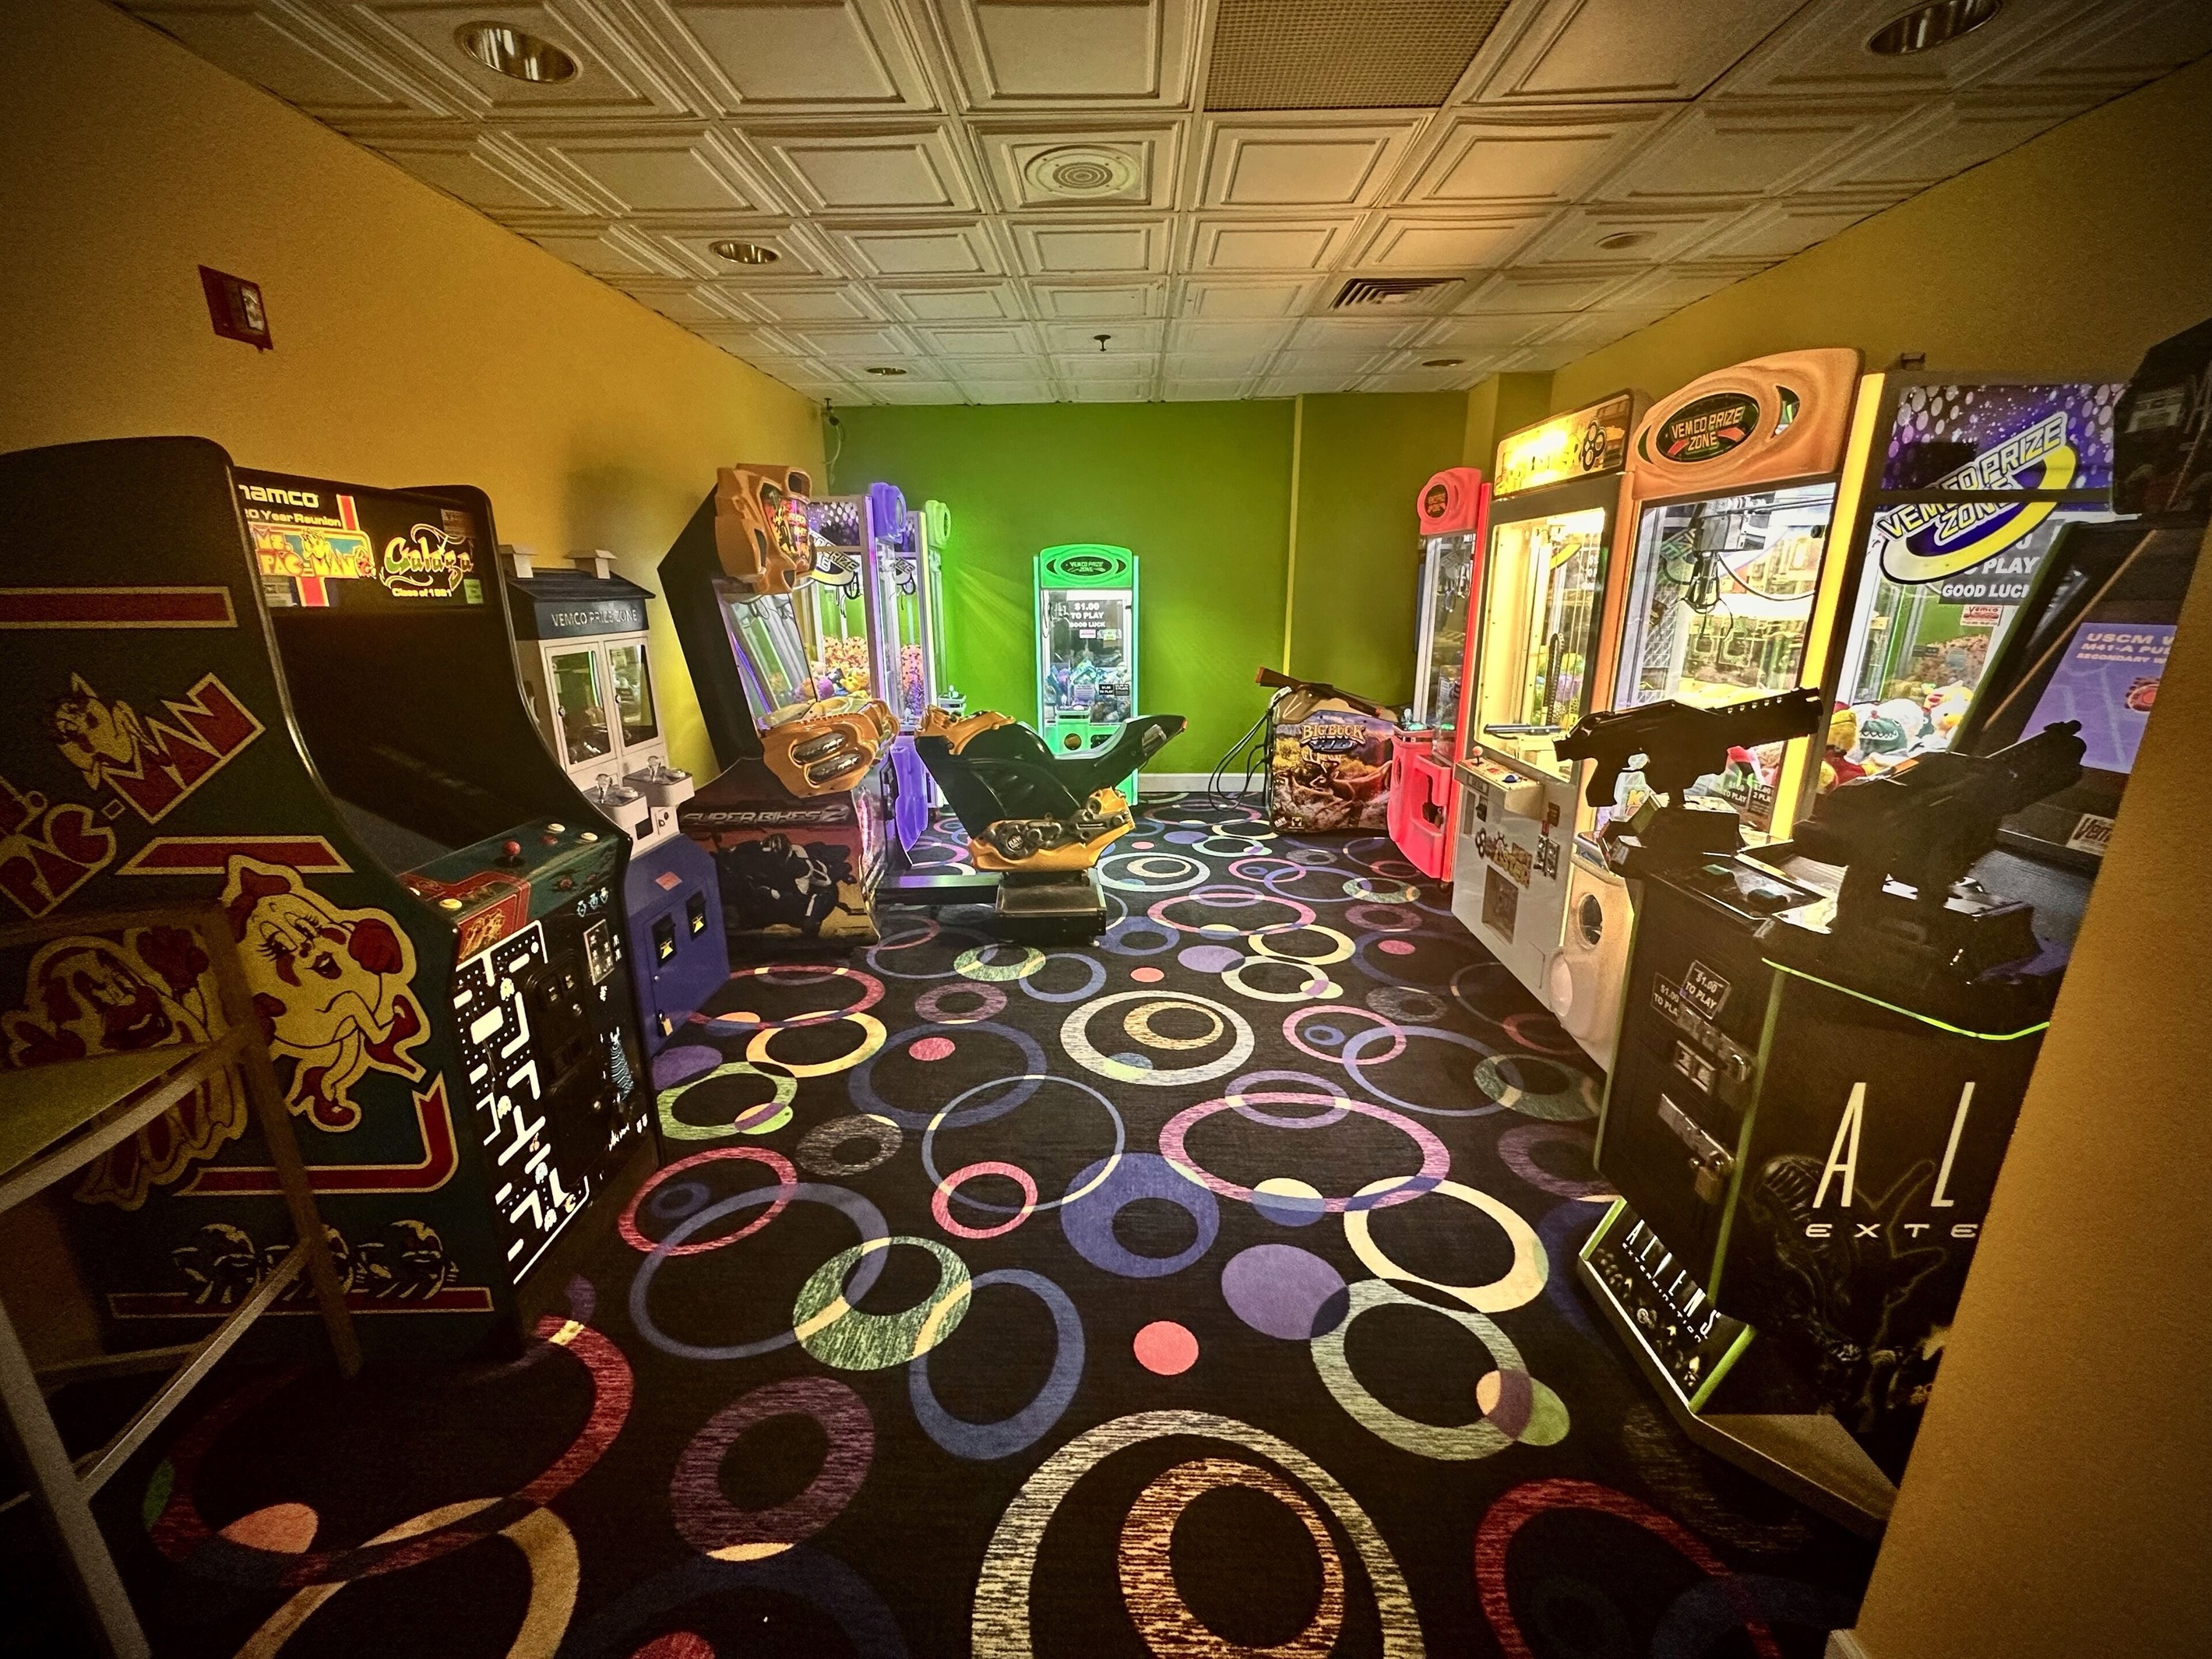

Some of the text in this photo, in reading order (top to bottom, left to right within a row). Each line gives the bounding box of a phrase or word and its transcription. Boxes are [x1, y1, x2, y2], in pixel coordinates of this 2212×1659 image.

[1671, 406, 1745, 439] VEMCO PRIZE
[1687, 431, 1718, 452] ZONE
[1979, 415, 2065, 484] PRIZE
[260, 509, 294, 523] Year
[294, 512, 341, 527] Reunion
[384, 534, 474, 592] Galaga
[1981, 556, 2041, 575] PLAY
[1942, 584, 1986, 598] GOOD
[1074, 602, 1100, 611] $1.00
[551, 609, 638, 627] VEMCO PRIZE ZONE
[2080, 643, 2134, 653] M41-A
[2087, 633, 2155, 645] USCM
[2076, 653, 2150, 663] SECONDARY
[1301, 724, 1366, 741] BIG BUCK
[1731, 792, 1747, 803] PLAY
[1660, 970, 1718, 1003] $1.00 $1.00
[1653, 981, 1717, 1017] TO PLAY TO PLA
[1626, 1218, 1721, 1337] ALIENS
